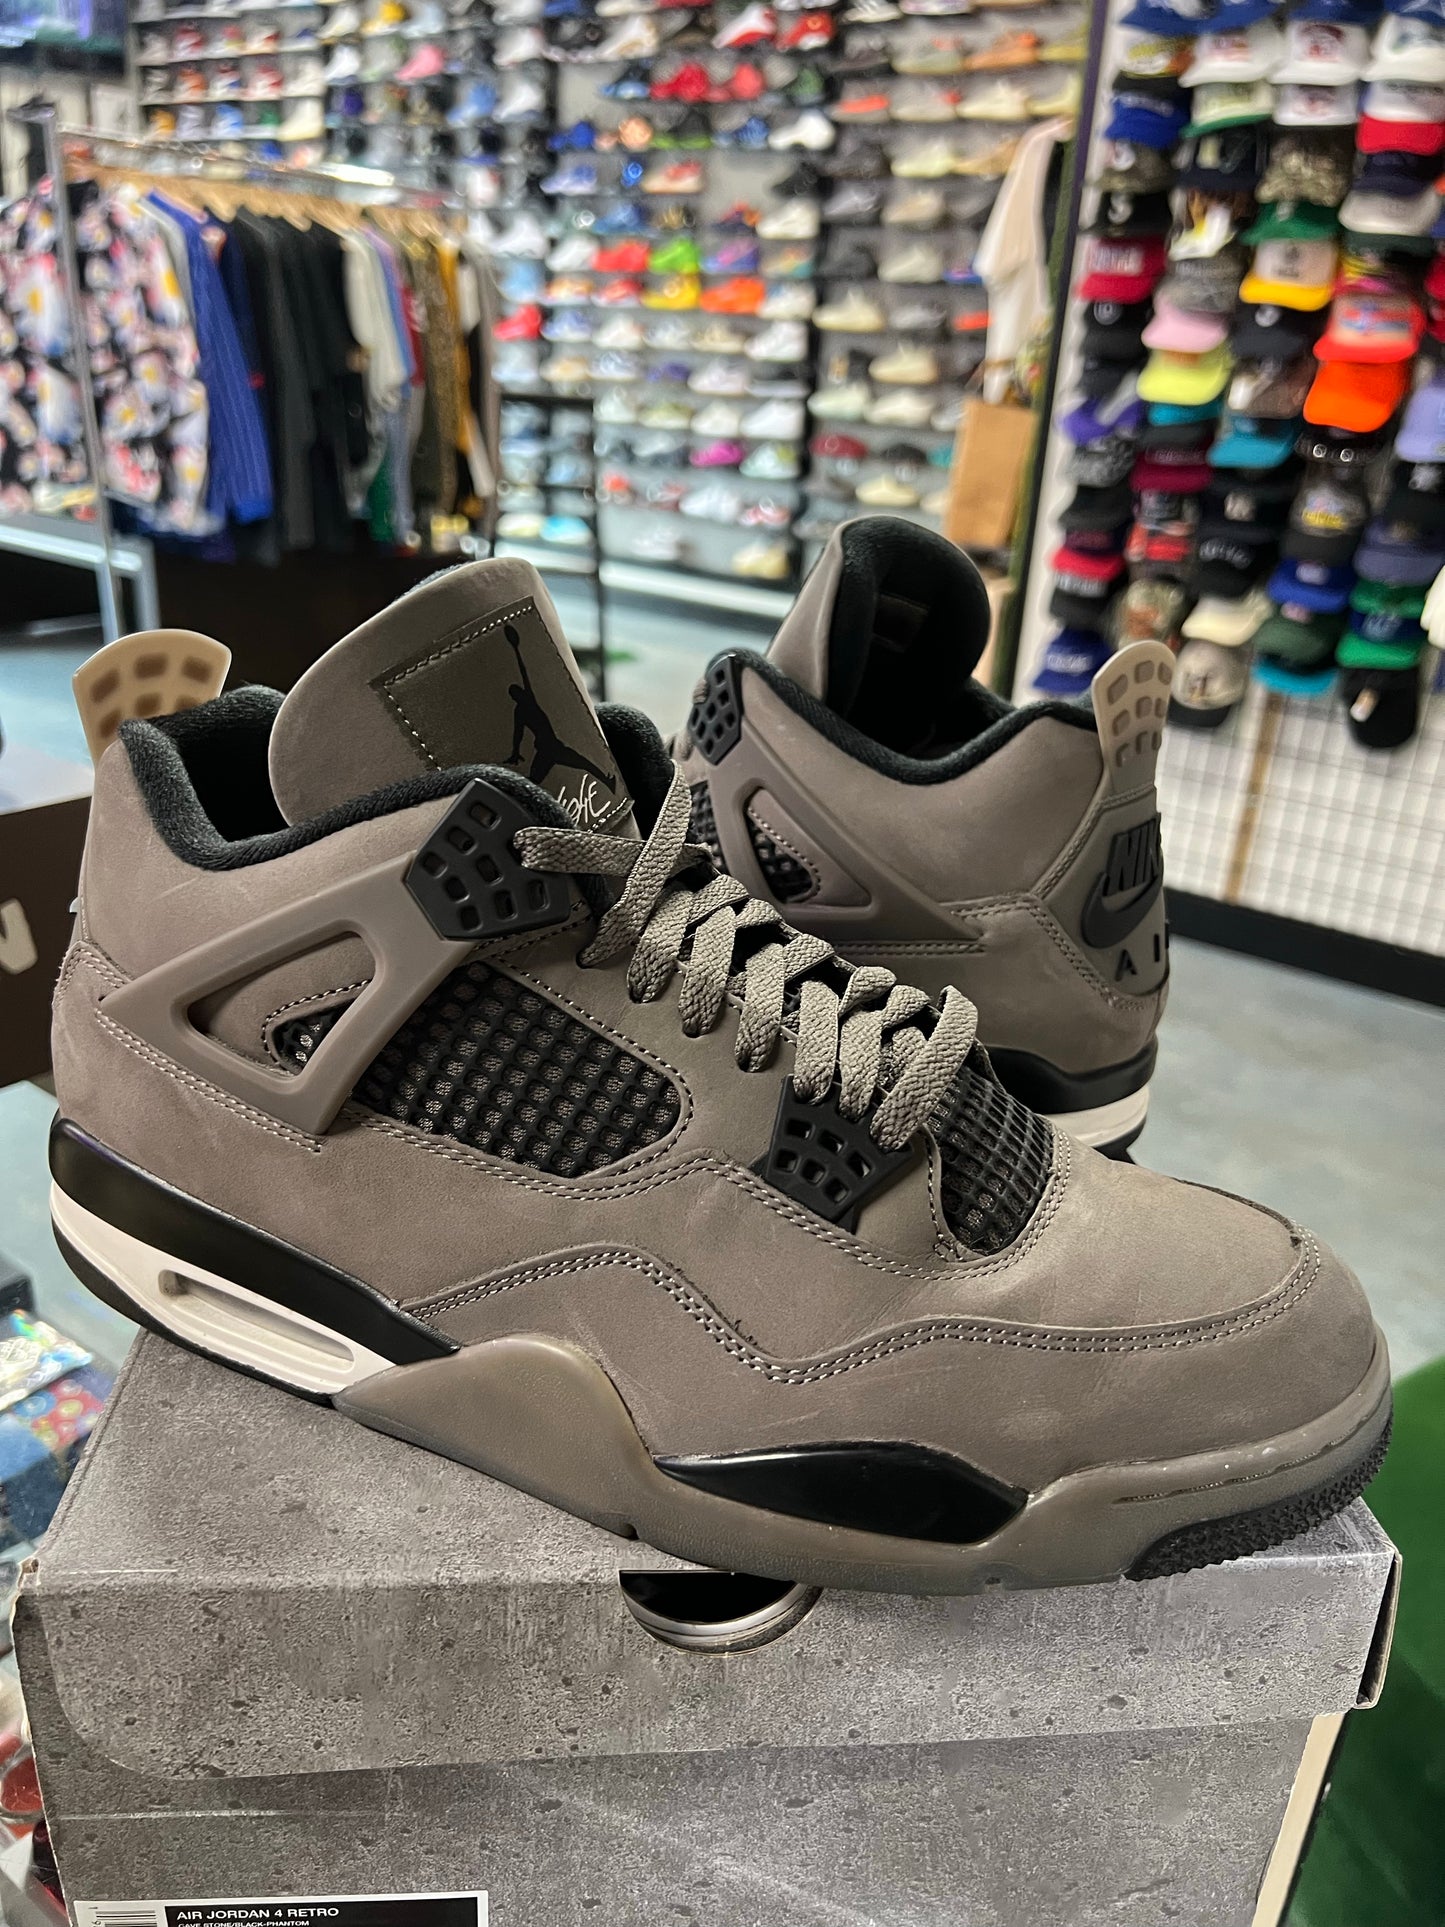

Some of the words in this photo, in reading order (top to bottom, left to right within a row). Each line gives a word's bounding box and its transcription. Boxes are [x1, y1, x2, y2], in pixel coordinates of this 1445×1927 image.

[1102, 813, 1163, 896] NIK
[1113, 921, 1170, 982] AI
[176, 1911, 203, 1920] AIR
[206, 1909, 270, 1919] JORDAN
[274, 1909, 283, 1917] 4
[287, 1907, 340, 1917] RETRO
